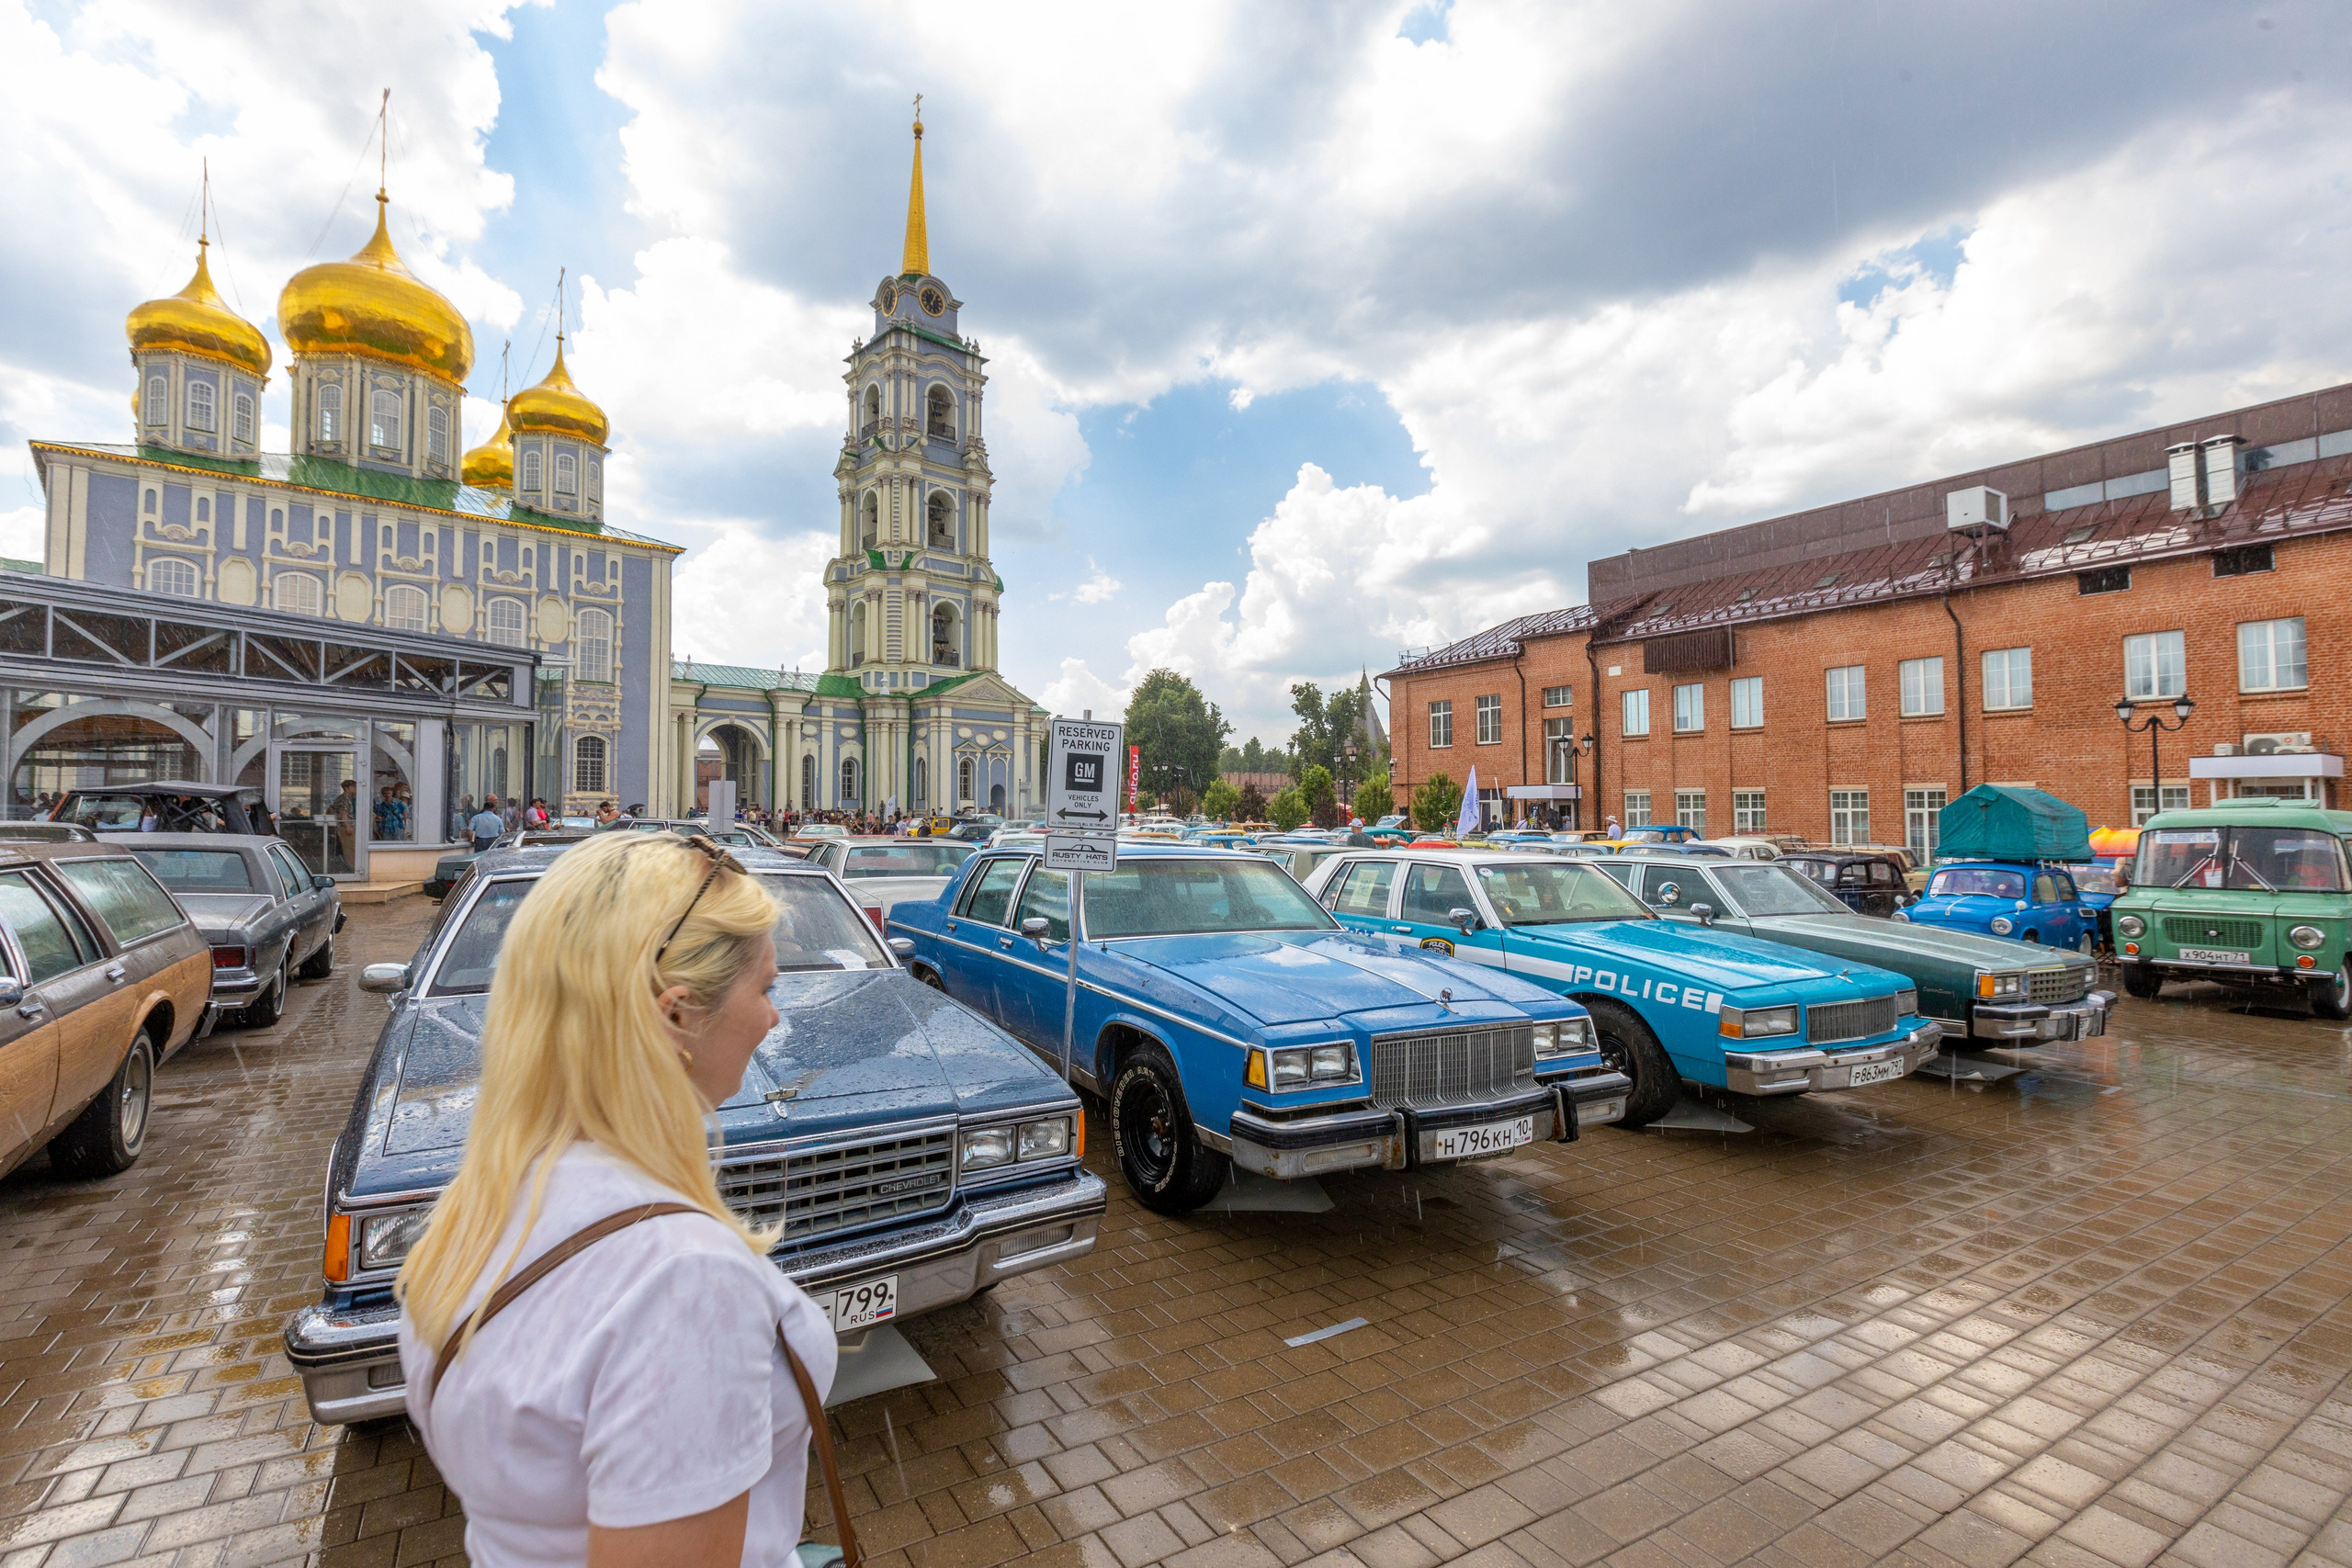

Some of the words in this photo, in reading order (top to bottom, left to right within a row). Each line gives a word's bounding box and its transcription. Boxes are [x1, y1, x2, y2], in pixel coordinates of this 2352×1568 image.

[1058, 727, 1114, 739] RESERVED
[1062, 739, 1110, 751] PARKING
[1075, 761, 1095, 778] GM
[1129, 754, 1139, 805] auto.ru
[1574, 965, 1705, 1010] POLICE
[1113, 1068, 1135, 1157] DISCOVERER
[1516, 1119, 1529, 1136] 10
[1514, 1136, 1524, 1145] RUS
[880, 1174, 942, 1194] CHEVROLET
[840, 1282, 889, 1317] 799
[851, 1311, 876, 1325] RUS
